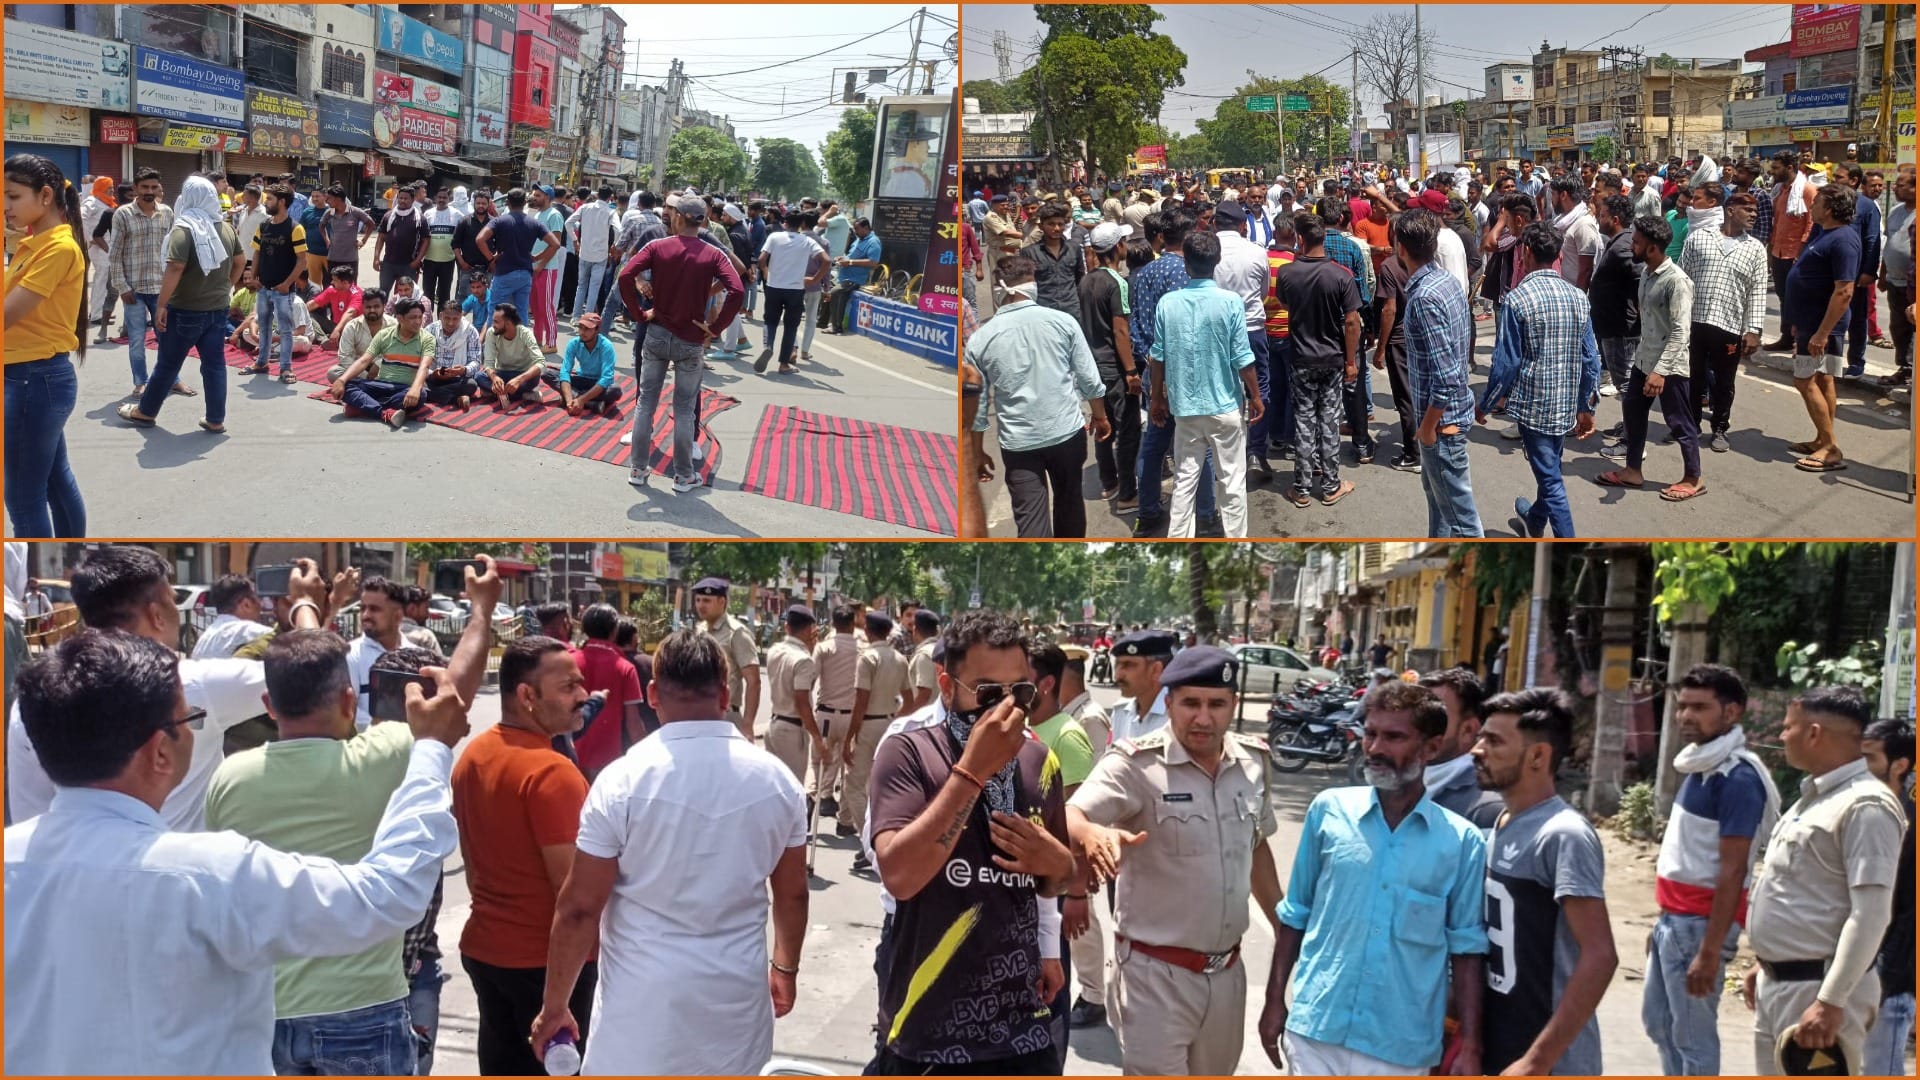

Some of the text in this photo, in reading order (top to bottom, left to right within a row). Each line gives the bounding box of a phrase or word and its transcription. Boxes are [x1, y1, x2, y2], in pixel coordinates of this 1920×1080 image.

[1797, 19, 1853, 40] BOMBAY
[435, 42, 455, 58] pepsi
[161, 59, 241, 91] Bombay Dyeing
[255, 91, 279, 105] Jam
[1796, 92, 1846, 104] Bombay Dyeing
[142, 105, 188, 119] RETAIL CENTRE
[251, 101, 308, 118] CHICKEN CORNER
[102, 119, 134, 129] BOMBAY
[323, 123, 338, 131] JAIN
[403, 116, 444, 138] PARDESI
[108, 128, 130, 138] TAILOR
[168, 129, 196, 140] Special
[169, 138, 189, 147] Offer
[301, 176, 317, 186] Jain
[872, 312, 949, 346] HDFC BANK
[1484, 876, 1517, 995] 9
[988, 949, 1029, 983] BVB
[952, 994, 1000, 1025] BVB
[1011, 1024, 1050, 1056] BVB
